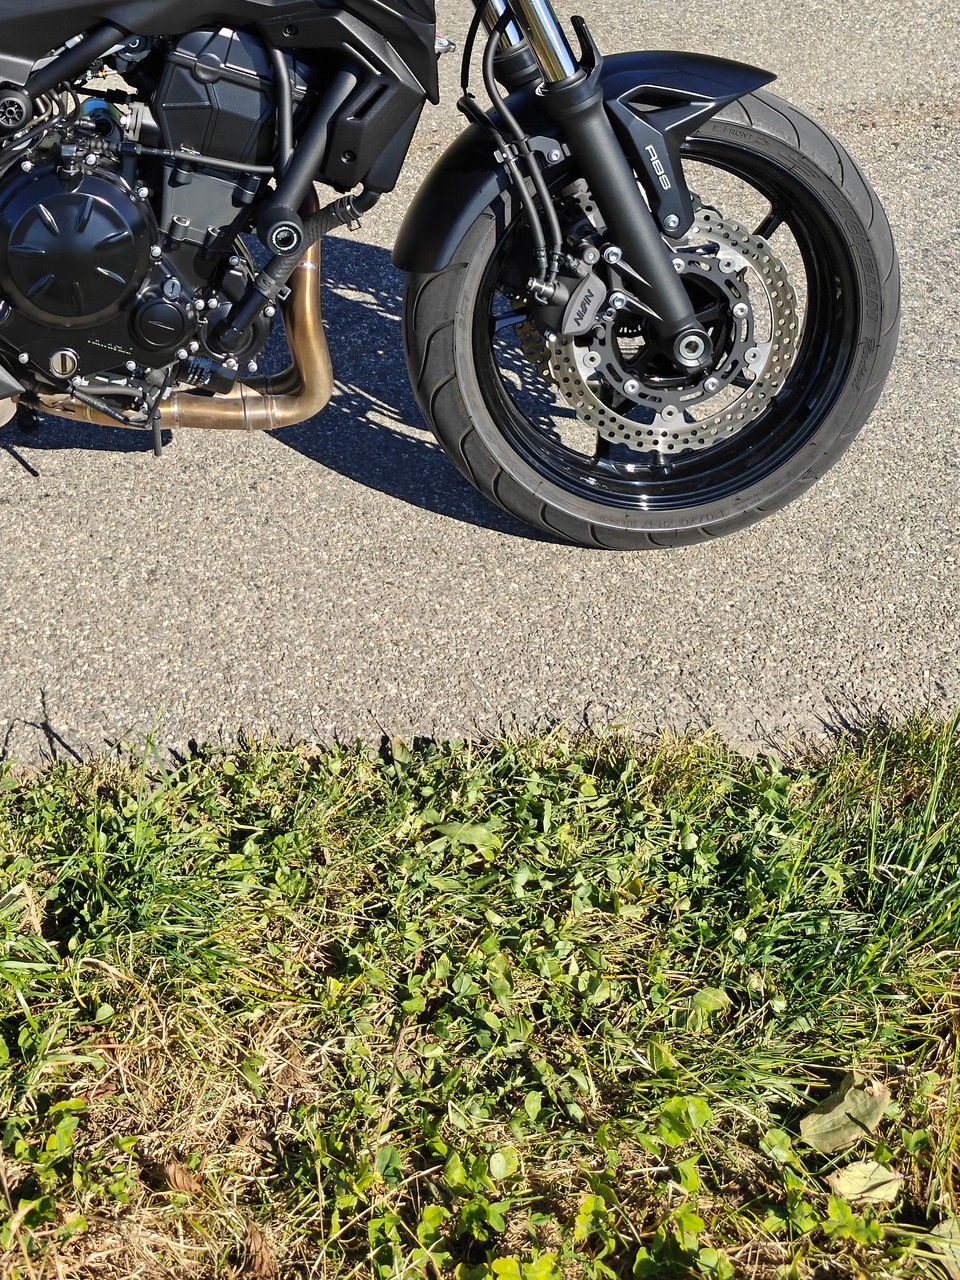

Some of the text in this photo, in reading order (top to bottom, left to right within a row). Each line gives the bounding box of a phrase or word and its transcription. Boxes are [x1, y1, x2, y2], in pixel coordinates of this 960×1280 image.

[723, 126, 754, 140] FRONT
[644, 144, 671, 191] ABS
[822, 183, 879, 321] MICHELIN
[573, 288, 595, 327] NISSIN
